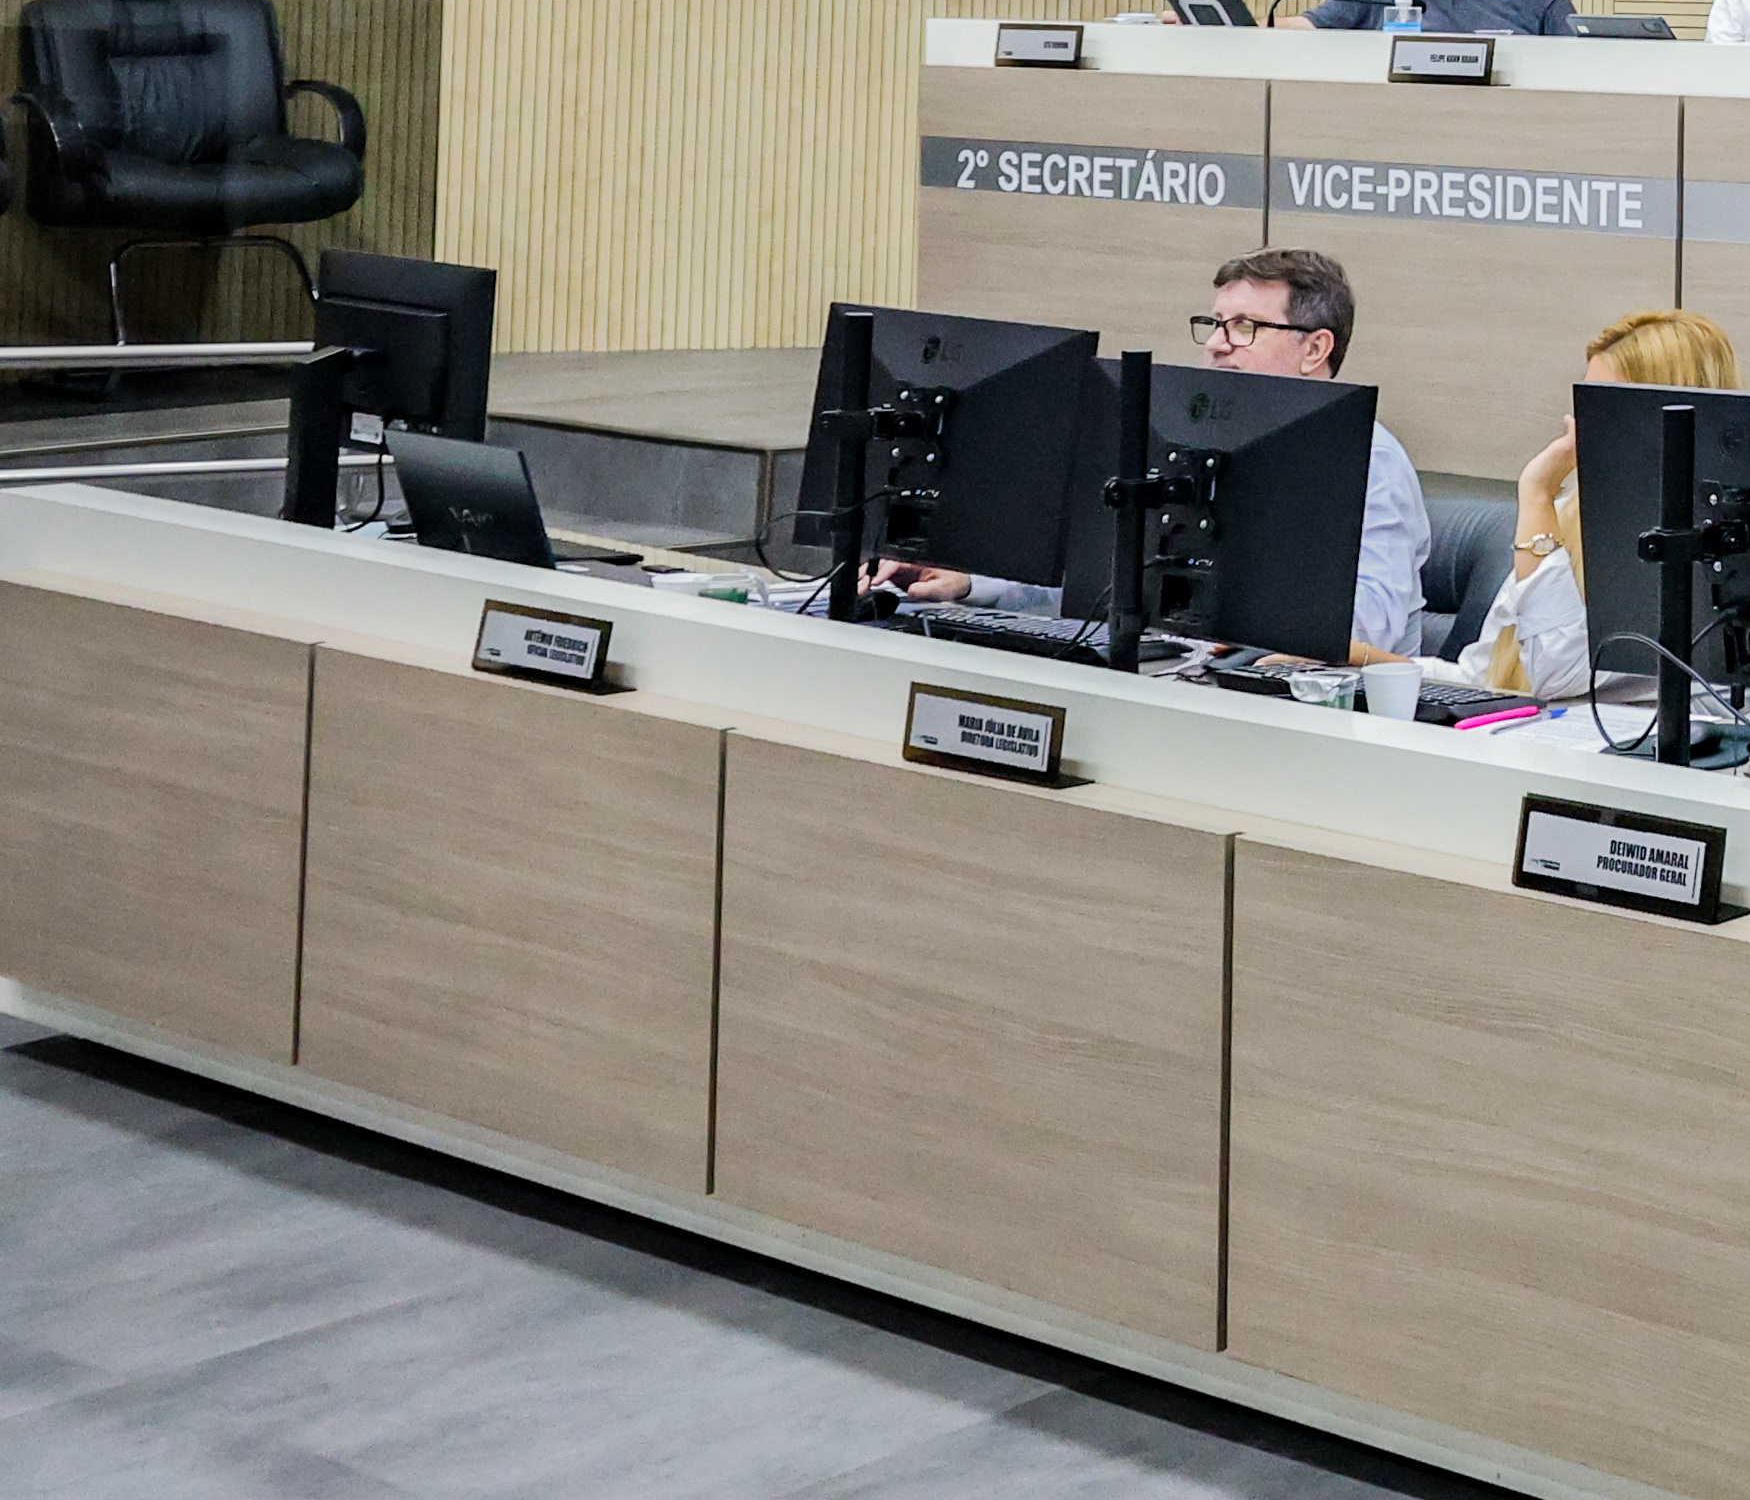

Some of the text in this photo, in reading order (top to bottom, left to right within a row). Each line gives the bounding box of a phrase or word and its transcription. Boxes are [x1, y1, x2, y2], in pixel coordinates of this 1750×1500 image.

[957, 148, 1226, 206] 2º SECRETÁRIO
[1288, 162, 1643, 229] VICE-PRESIDENTE
[1596, 855, 1687, 887] PROCURADOR GERAL
[1609, 839, 1689, 870] DEIWID AMARAL
